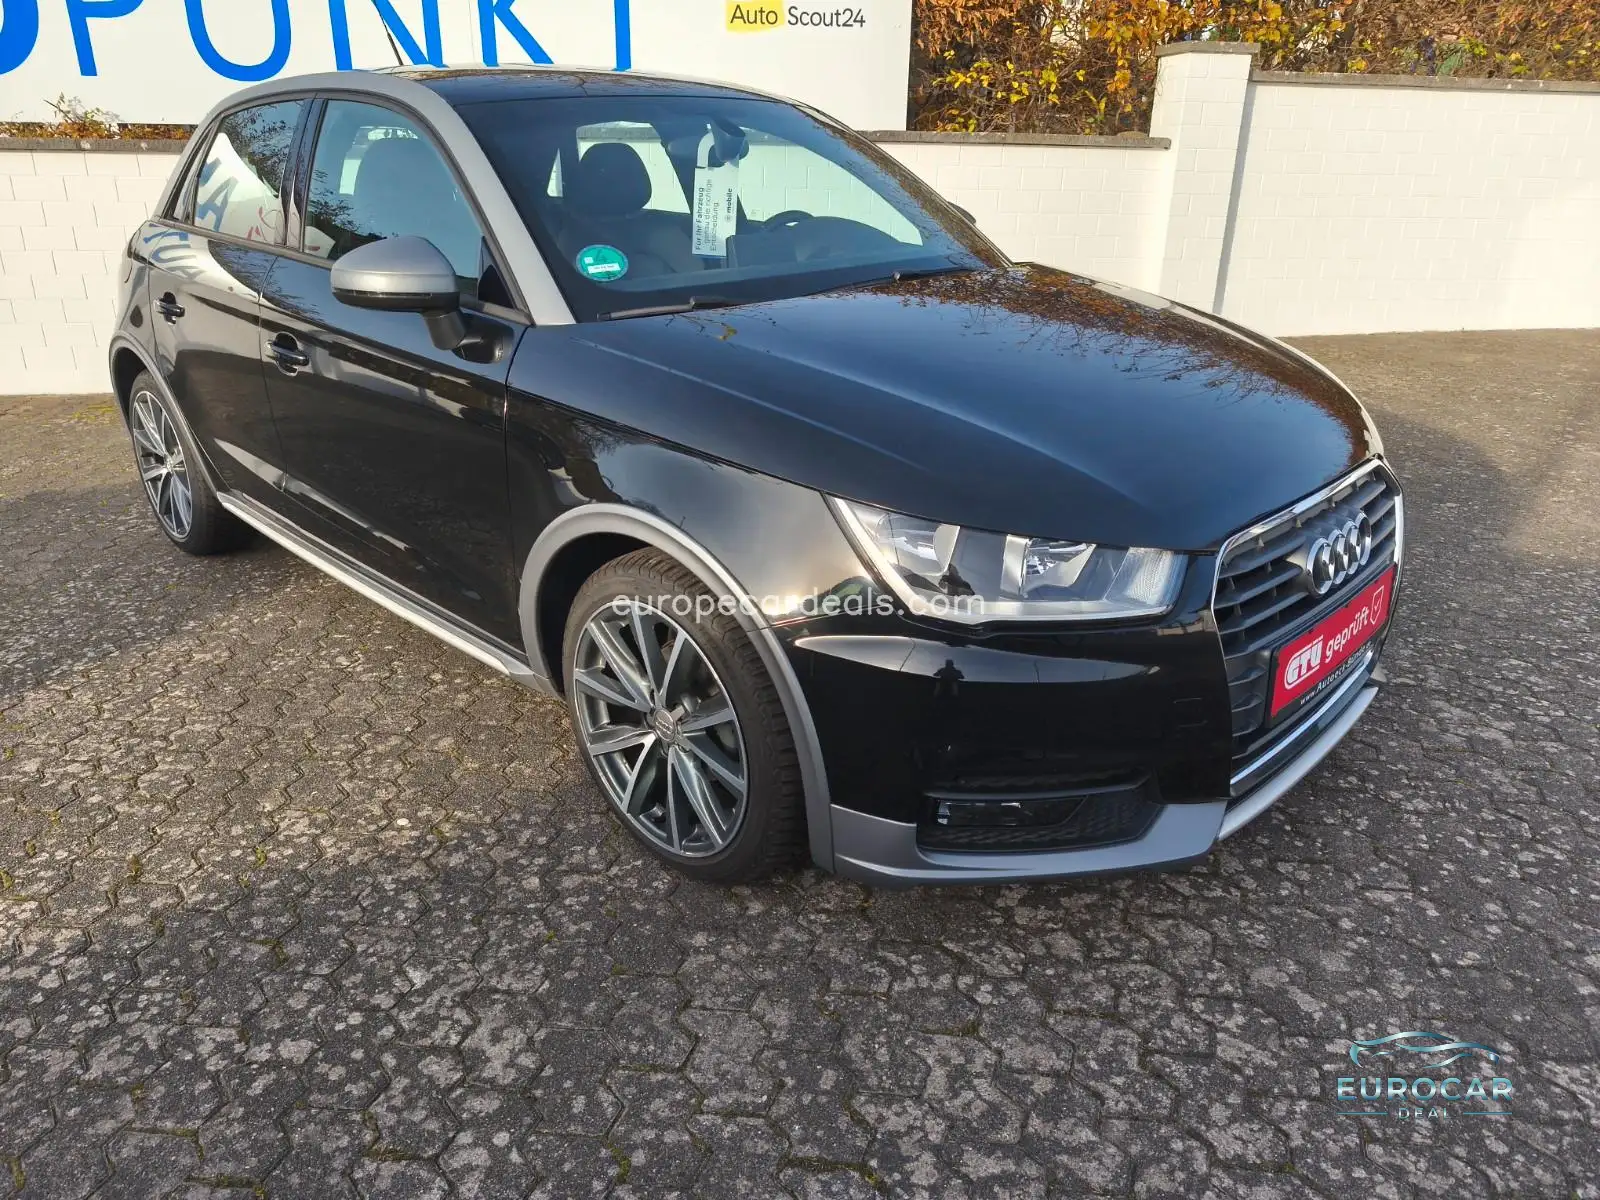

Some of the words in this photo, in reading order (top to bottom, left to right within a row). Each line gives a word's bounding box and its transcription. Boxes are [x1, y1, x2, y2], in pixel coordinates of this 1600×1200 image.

[730, 4, 778, 26] Auto
[787, 6, 866, 28] Scout24
[696, 187, 705, 224] Fahrzeug
[1325, 606, 1369, 664] geprüft
